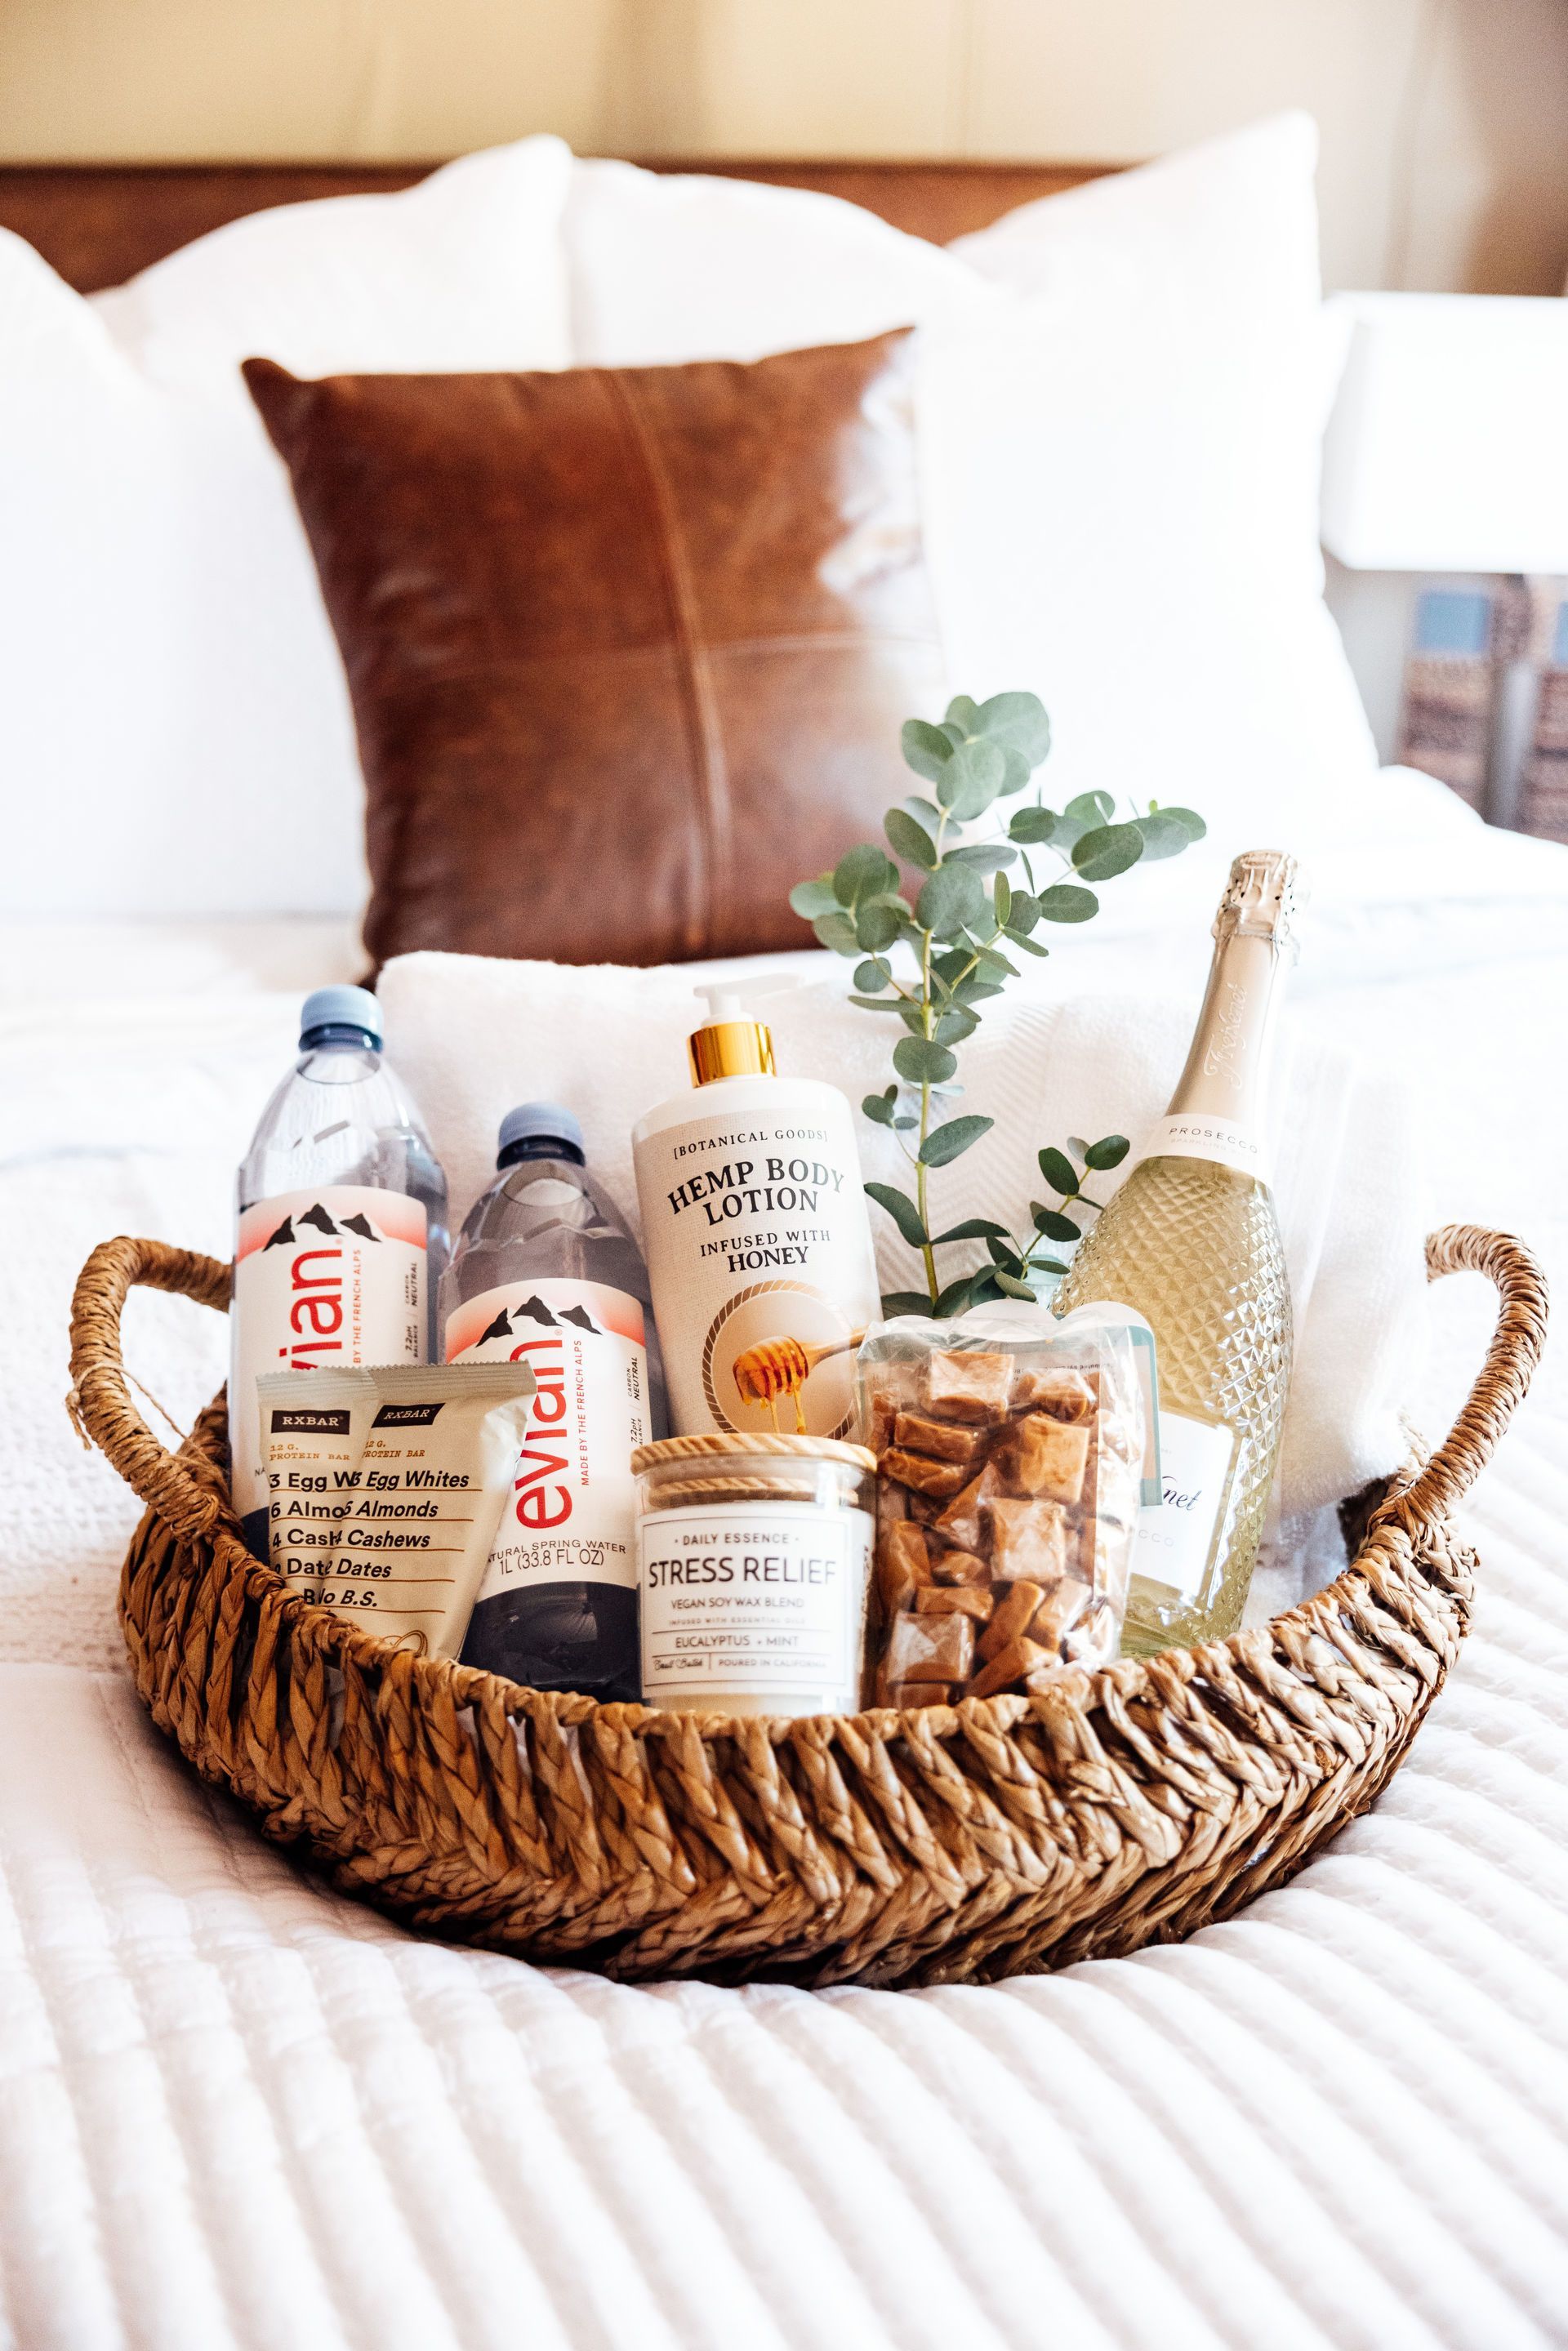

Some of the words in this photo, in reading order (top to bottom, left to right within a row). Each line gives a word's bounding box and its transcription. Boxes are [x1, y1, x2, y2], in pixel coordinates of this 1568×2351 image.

[674, 1131, 768, 1160] [BOTANICAL
[775, 1129, 827, 1142] GOODS]
[1169, 1128, 1258, 1154] PROSECCO
[667, 1161, 754, 1215] HEMP
[765, 1158, 844, 1193] BODY
[703, 1187, 817, 1226] LOTION
[701, 1233, 777, 1257] INFUSED
[786, 1230, 831, 1241] WITH
[353, 1249, 361, 1275] ALPS
[728, 1246, 808, 1272] HONEY
[353, 1279, 361, 1323] FRENCH
[353, 1325, 361, 1346] THE
[353, 1351, 361, 1364] BY
[574, 1340, 582, 1365] ALPS
[632, 1356, 640, 1400] NEUTRAL
[577, 1369, 585, 1413] FRENCH
[283, 1416, 339, 1426] RXBAR
[383, 1409, 430, 1419] RXBAR
[509, 1339, 572, 1529] evian
[578, 1414, 586, 1438] THE
[580, 1440, 587, 1451] BY
[270, 1453, 319, 1461] PROTEIN
[581, 1454, 589, 1485] MADE
[270, 1474, 280, 1488] 3
[288, 1472, 327, 1492] Egg
[366, 1472, 400, 1491] Egg
[405, 1471, 470, 1487] Whites
[271, 1503, 281, 1518] 6
[355, 1500, 439, 1517] Almonds
[273, 1533, 281, 1547] 4
[347, 1529, 430, 1547] Cashews
[532, 1539, 581, 1551] SPRING
[586, 1540, 626, 1553] WATER
[684, 1534, 718, 1545] DAILY
[724, 1533, 790, 1544] ESSENCE
[336, 1558, 392, 1578] Dates
[499, 1558, 513, 1574] 1L
[517, 1550, 551, 1570] (33.8
[557, 1549, 574, 1565] FL
[579, 1548, 604, 1565] OZ)
[648, 1557, 734, 1587] STRESS
[743, 1556, 836, 1584] RELIEF
[341, 1590, 377, 1607] B.S.
[670, 1598, 706, 1610] VEGAN
[709, 1597, 732, 1609] SOY
[735, 1598, 760, 1608] WAX
[764, 1597, 804, 1609] BLEND
[675, 1635, 750, 1649] EUCALYPTUS
[766, 1636, 799, 1646] MINT
[719, 1659, 756, 1667] POURED
[760, 1659, 770, 1667] IN
